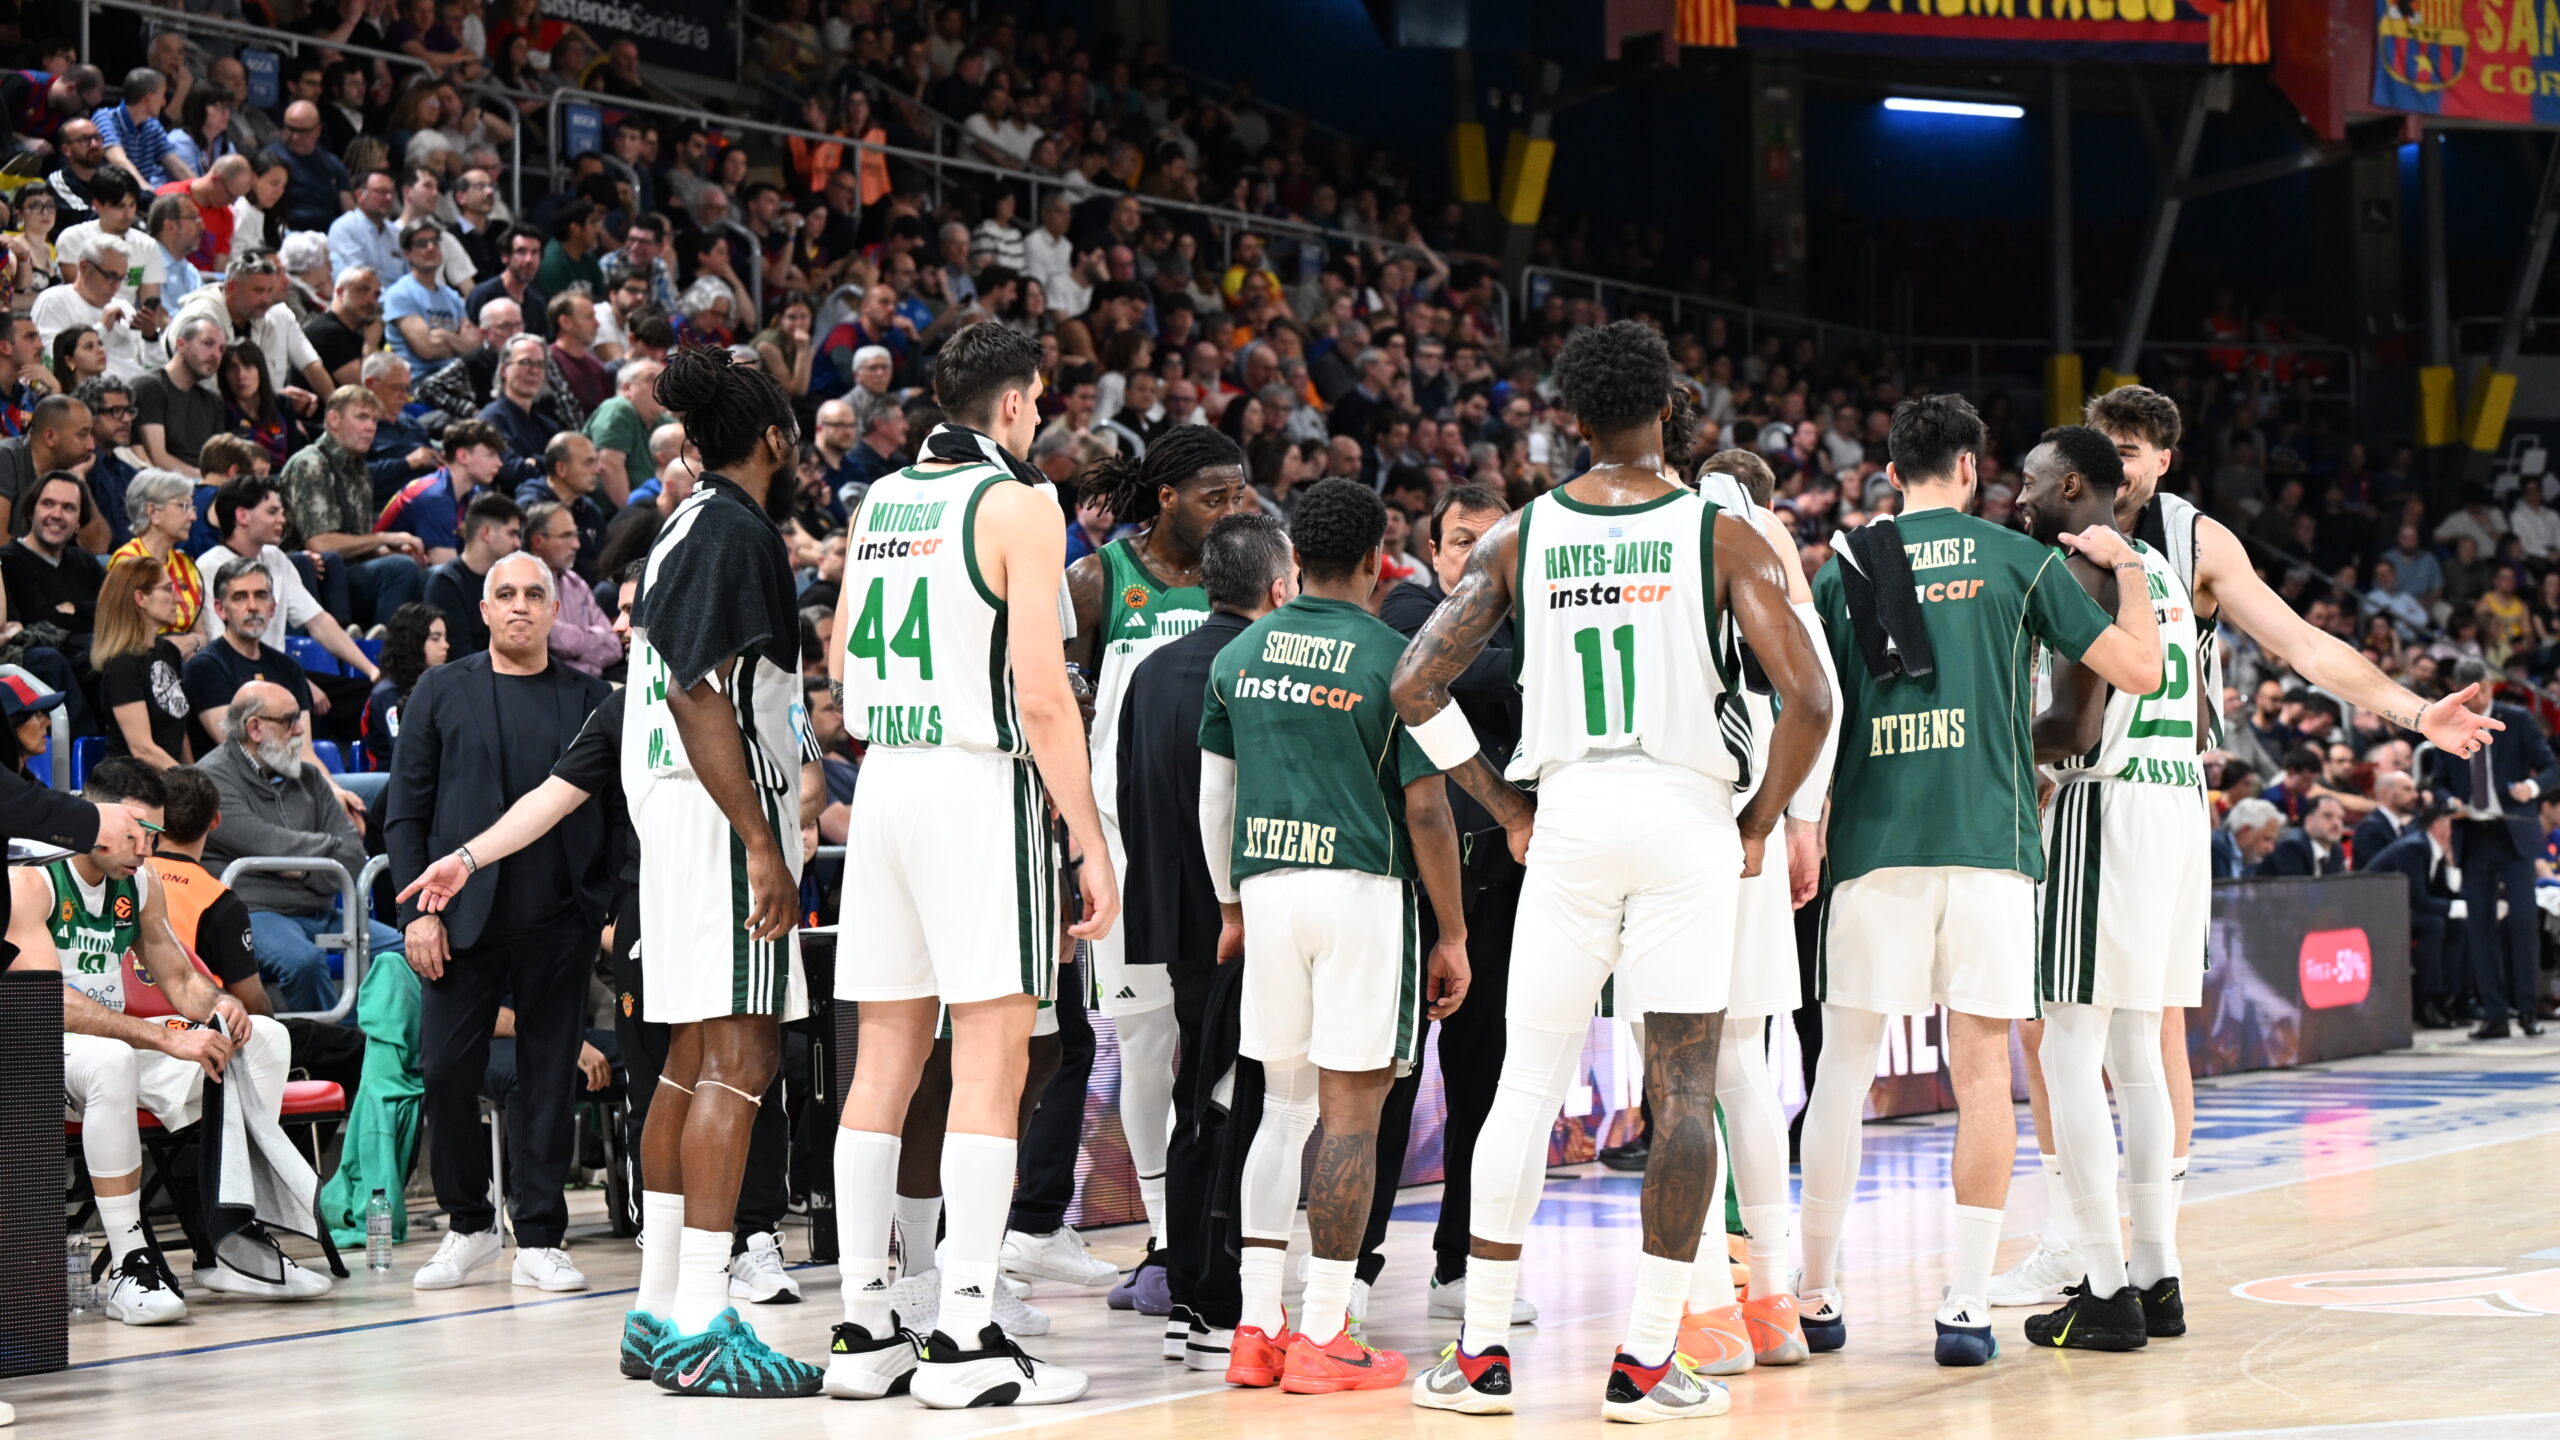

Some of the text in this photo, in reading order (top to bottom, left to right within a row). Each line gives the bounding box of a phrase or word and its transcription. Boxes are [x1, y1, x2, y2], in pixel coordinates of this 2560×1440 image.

[868, 500, 948, 532] MITOGLOU
[857, 536, 943, 560] instacar
[1545, 541, 1673, 580] HAYES-DAVIS
[1962, 537, 1977, 565] P.
[1549, 582, 1672, 609] instacar
[847, 577, 933, 680] 44
[1262, 631, 1334, 670] SHORTS
[1235, 669, 1363, 712] instacar
[1574, 624, 1635, 735] 11
[1870, 708, 1965, 757] ATHENS
[1243, 816, 1336, 865] ATHENS
